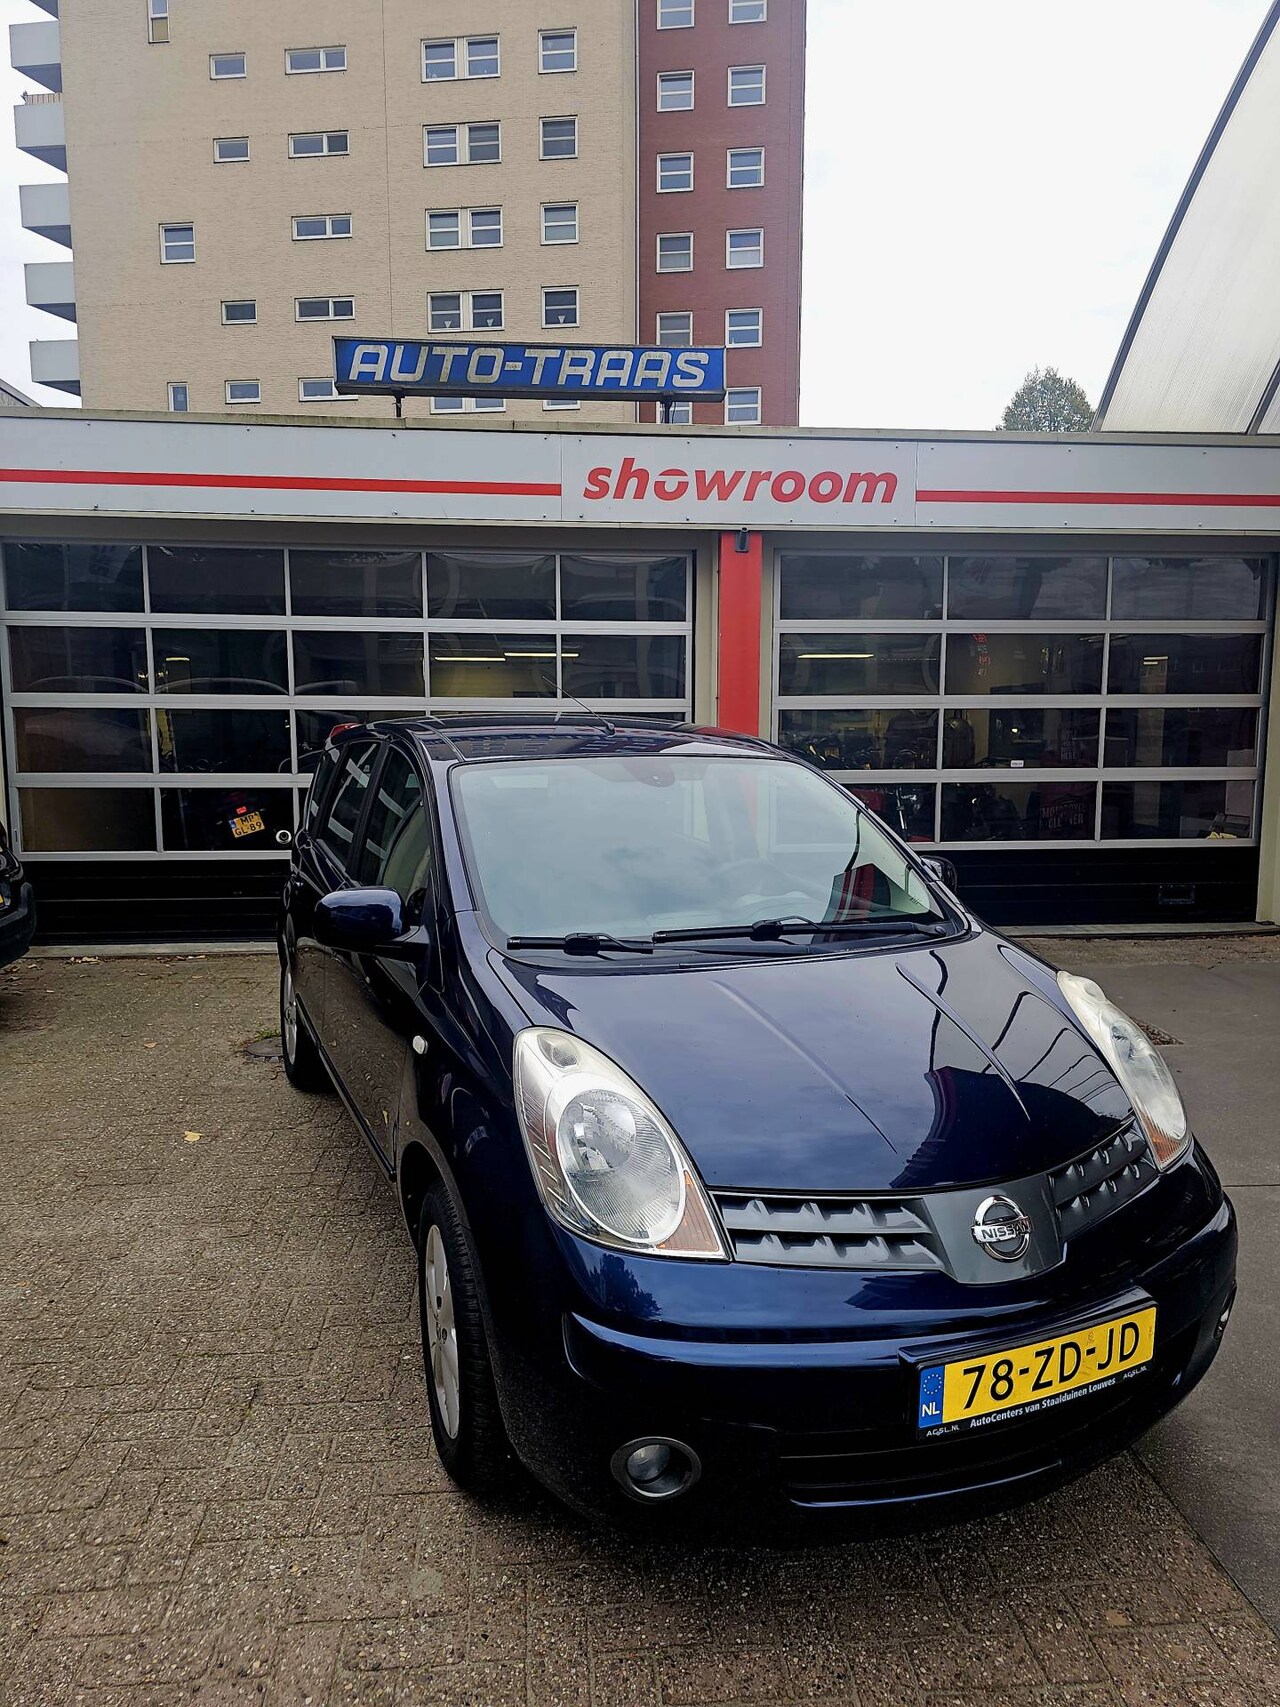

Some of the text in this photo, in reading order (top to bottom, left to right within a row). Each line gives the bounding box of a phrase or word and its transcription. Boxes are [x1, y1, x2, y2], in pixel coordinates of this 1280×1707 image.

[349, 344, 709, 388] AUTO-TRAAS
[582, 457, 898, 504] showroom
[981, 1219, 1030, 1239] NISSAN
[963, 1321, 1140, 1410] 78-ZD-JD
[921, 1401, 941, 1418] NL
[969, 1377, 1117, 1429] AutoCenters van Staalduinen Louwes
